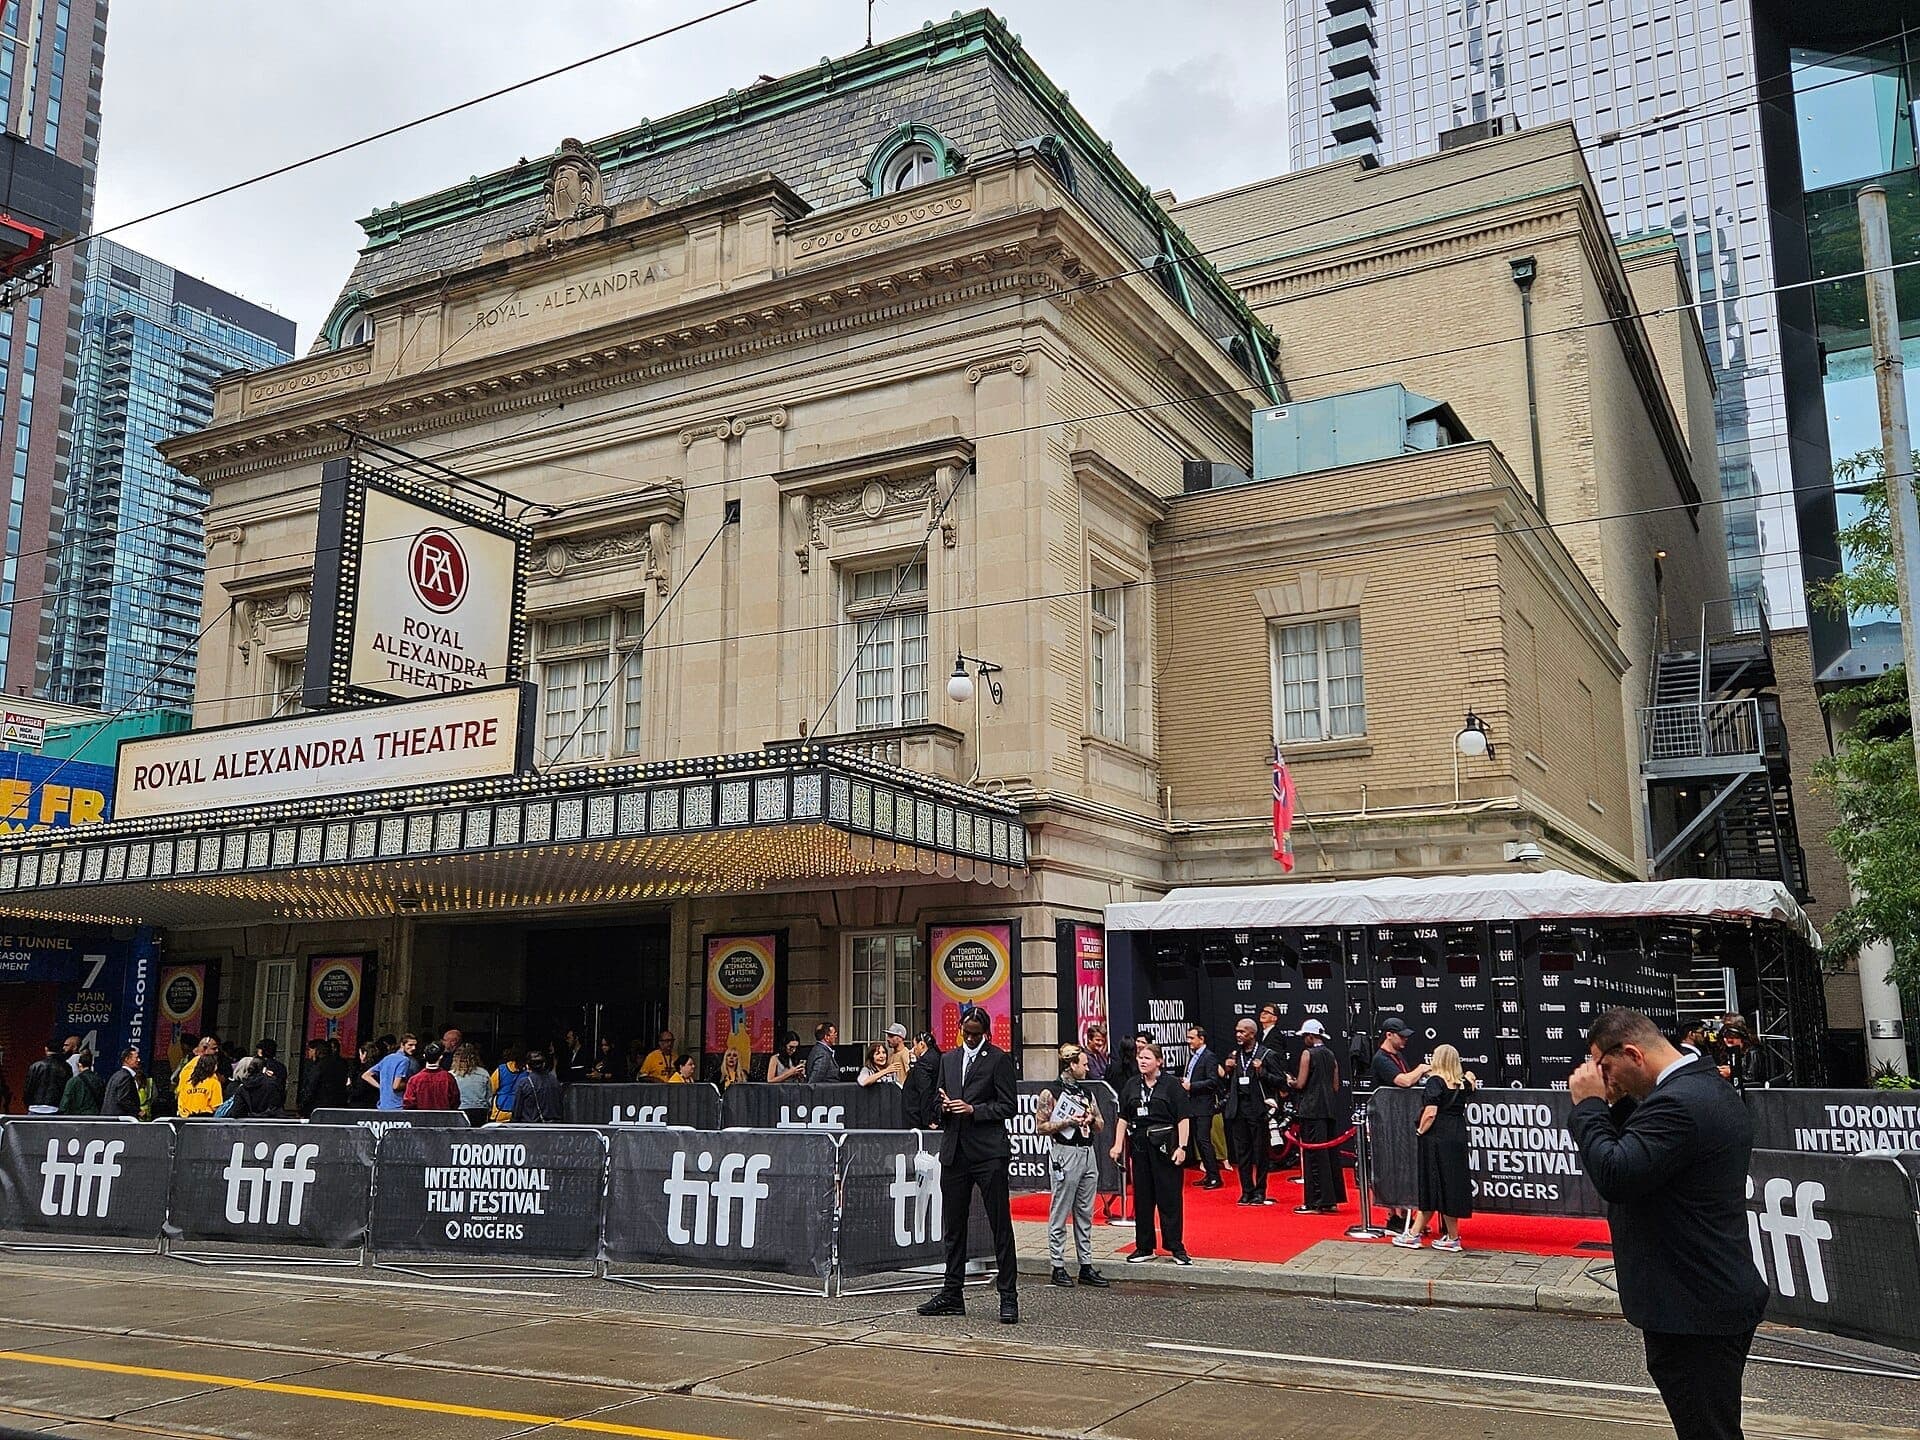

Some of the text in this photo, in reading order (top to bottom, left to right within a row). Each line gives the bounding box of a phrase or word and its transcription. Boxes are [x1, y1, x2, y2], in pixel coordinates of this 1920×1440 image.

[476, 266, 656, 331] ROYAL ALEXANDRA
[403, 616, 464, 650] ROYAL
[371, 633, 489, 680] ALEXANDRA
[133, 717, 499, 791] ROYAL ALEXANDRA THEATRE
[18, 937, 73, 950] TUNNEL
[82, 954, 107, 989] 7
[1542, 975, 1560, 987] tiff
[1237, 980, 1252, 991] tiff
[1307, 979, 1323, 990] tiff
[1380, 977, 1397, 989] tiff
[1460, 976, 1477, 988] tiff
[77, 992, 105, 1001] MAIN
[67, 1003, 113, 1013] SEASON
[68, 1013, 110, 1023] SHOWS
[1148, 999, 1185, 1021] TORONTO
[1303, 1004, 1329, 1014] VISA
[1421, 1002, 1438, 1014] tiff
[1463, 1027, 1480, 1039] tiff
[1545, 1027, 1563, 1039] tiff
[1465, 1102, 1552, 1127] ORONTO
[1824, 1104, 1920, 1129] TORONT
[451, 1143, 527, 1166] TORONTO
[1487, 1150, 1583, 1176] FESTIVAL
[40, 1138, 125, 1218] tiff
[223, 1142, 320, 1225] tiff
[424, 1167, 550, 1191] INTERNATIONAL
[663, 1151, 771, 1248] tiff
[1483, 1181, 1559, 1200] ROGERS
[427, 1190, 545, 1215] FILM FESTIVAL
[463, 1223, 524, 1240] ROGERS
